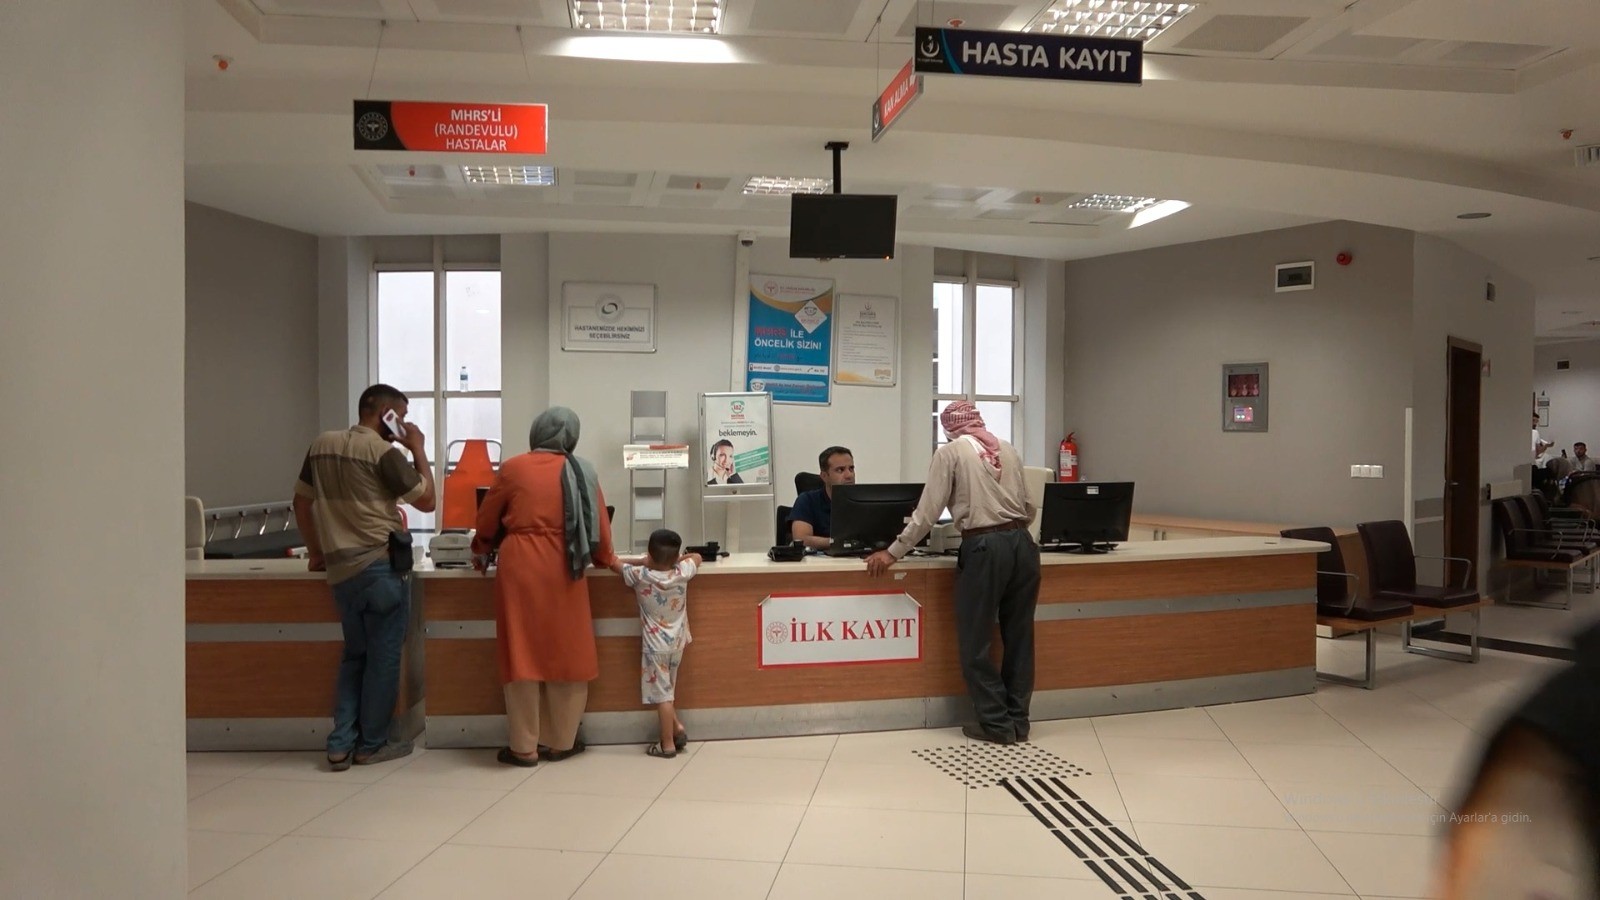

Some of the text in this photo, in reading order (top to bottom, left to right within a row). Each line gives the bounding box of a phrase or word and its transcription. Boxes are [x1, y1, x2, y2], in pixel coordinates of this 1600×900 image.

[962, 40, 1132, 73] HASTA KAYIT
[434, 123, 518, 140] (RANDEVULU)
[446, 138, 507, 151] HASTALAR
[790, 328, 805, 339] İLE
[754, 337, 795, 349] ÖNCELİK
[718, 429, 758, 438] beklemeyin.
[790, 617, 916, 643] İLK KAYIT
